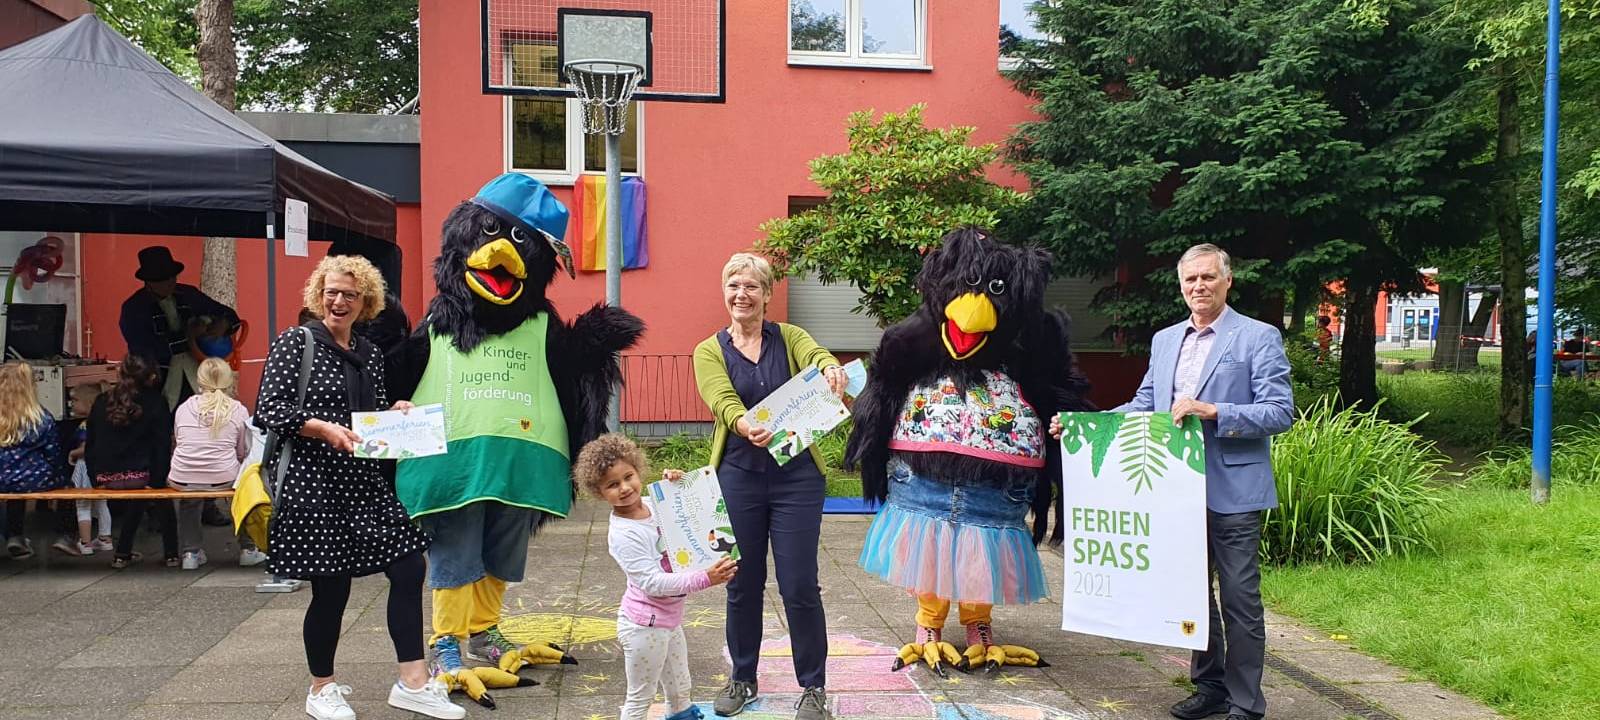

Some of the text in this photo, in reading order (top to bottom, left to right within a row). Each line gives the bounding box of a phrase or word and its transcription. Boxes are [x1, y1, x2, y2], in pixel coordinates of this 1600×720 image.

[483, 346, 532, 361] Kinder-
[460, 370, 514, 386] Jugend-
[506, 361, 526, 372] und
[463, 387, 532, 406] förderung
[770, 387, 819, 433] ommerferien
[1072, 507, 1150, 537] FERIEN
[1073, 537, 1150, 572] SPASS
[1073, 571, 1113, 598] 2021
